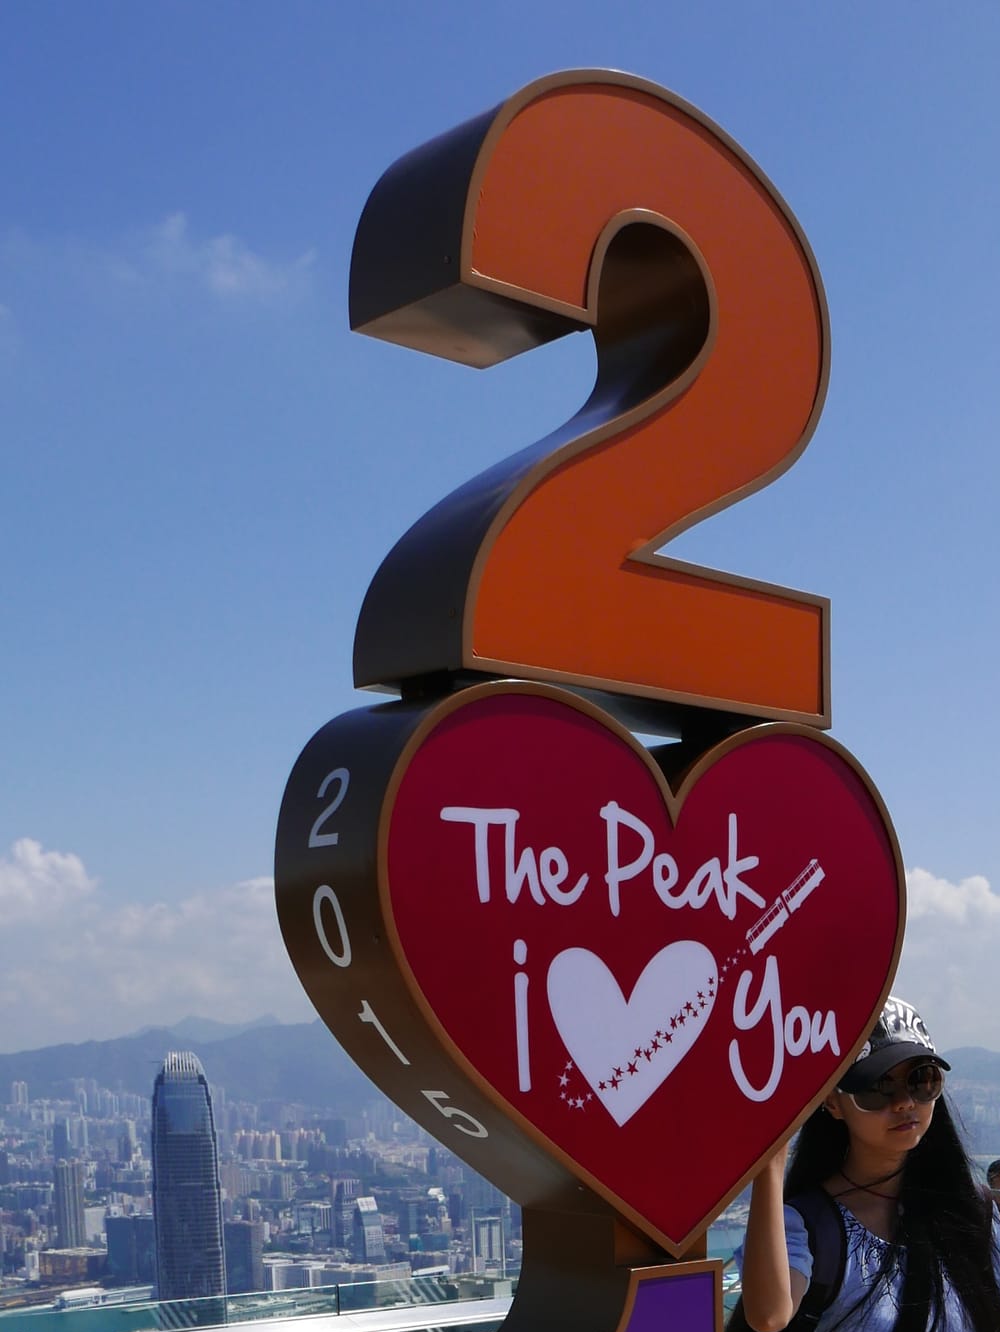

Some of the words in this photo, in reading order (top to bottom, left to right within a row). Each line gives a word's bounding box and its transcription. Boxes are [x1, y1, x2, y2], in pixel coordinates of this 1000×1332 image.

[461, 67, 832, 731] 2
[440, 807, 589, 905] The
[600, 801, 766, 920] Peak
